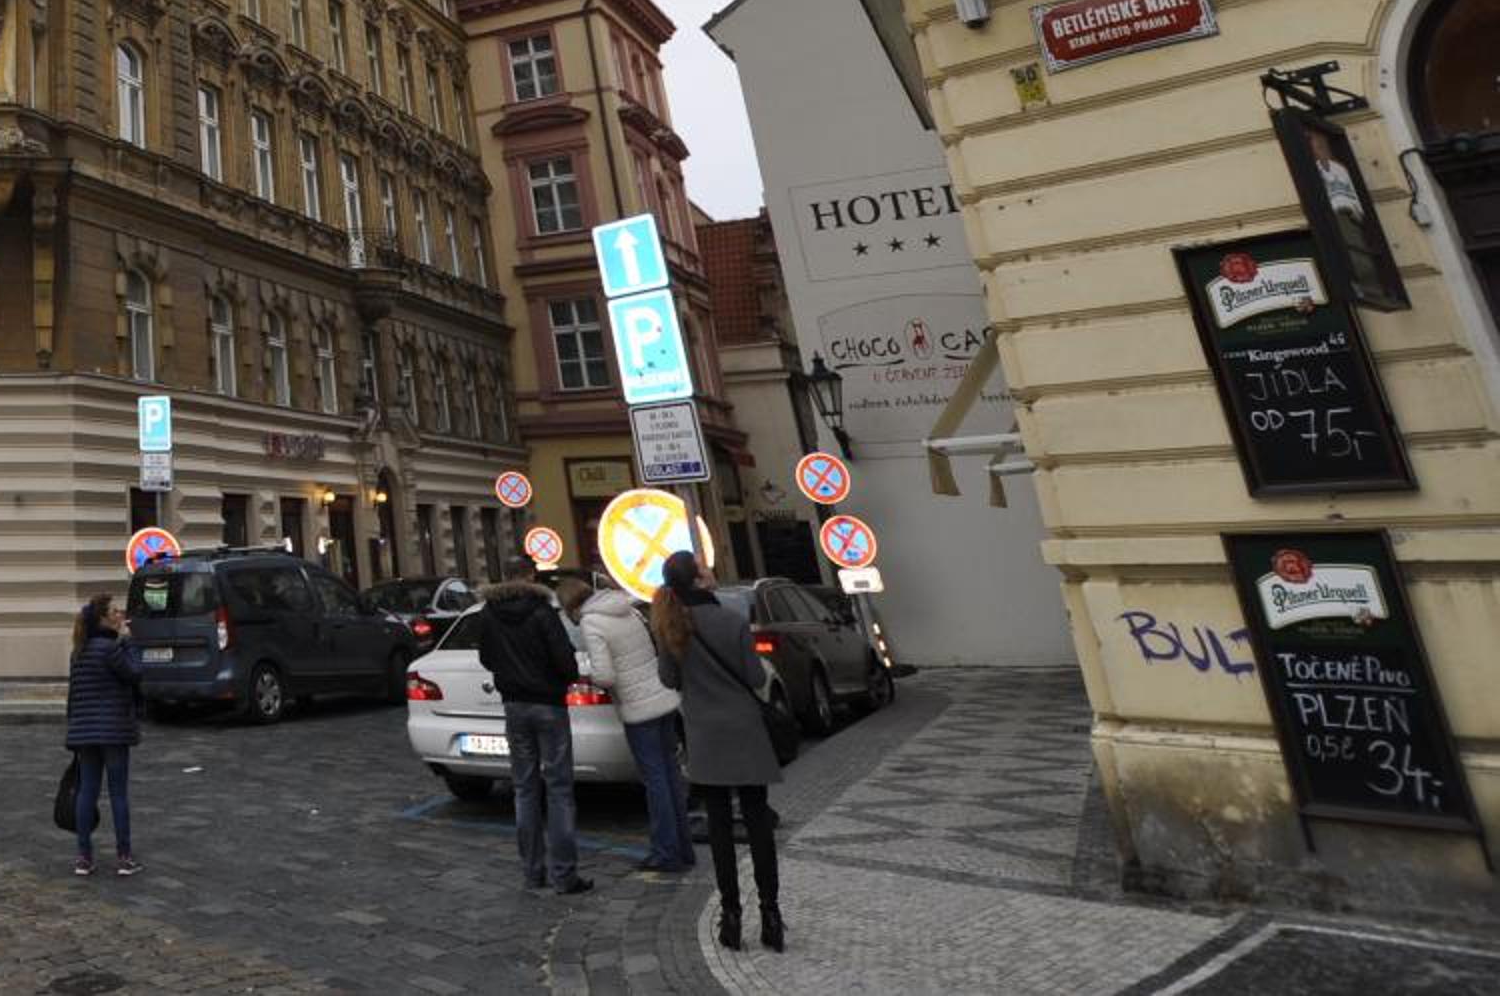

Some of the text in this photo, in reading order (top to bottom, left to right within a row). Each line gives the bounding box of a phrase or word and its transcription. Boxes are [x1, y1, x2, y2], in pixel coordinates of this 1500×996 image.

[1068, 30, 1099, 50] STARÉ
[1219, 275, 1309, 313] Pilsner Urquell
[624, 307, 662, 366] P
[831, 337, 901, 360] CHOCO
[1246, 365, 1347, 401] JÍDLA
[1251, 409, 1284, 431] OD
[1271, 582, 1369, 613] Pilsner Urquell
[1278, 654, 1364, 681] TOČENÉ
